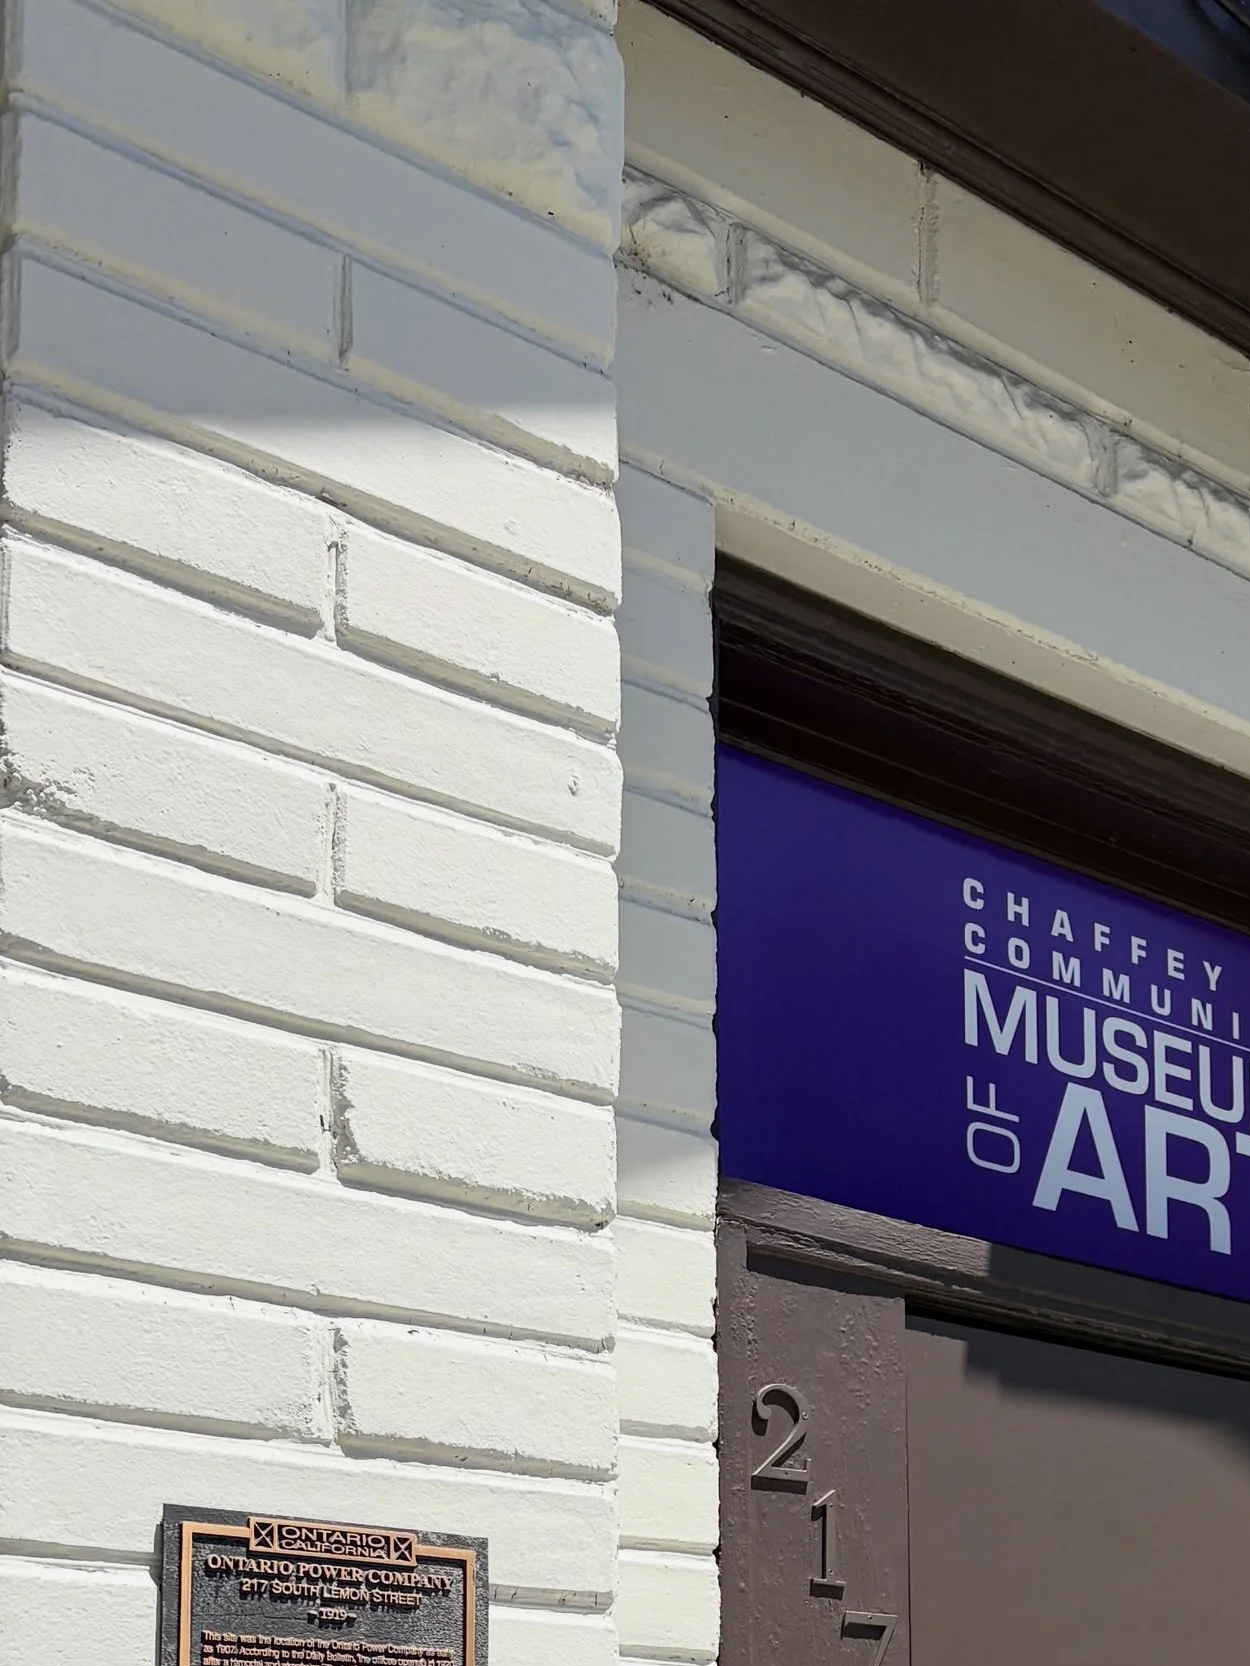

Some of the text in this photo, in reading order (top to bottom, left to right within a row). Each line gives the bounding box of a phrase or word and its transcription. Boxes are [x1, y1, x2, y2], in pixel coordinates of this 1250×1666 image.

[963, 877, 1223, 992] CHAFFEY
[966, 1075, 1021, 1174] OF
[281, 1540, 389, 1560] CALIFORNIA
[282, 1526, 385, 1547] ONTARIO
[207, 1554, 453, 1590] ONTARIO POWER COMPANY
[241, 1579, 424, 1606] 217 SOUTH LEMON STREET
[203, 1630, 220, 1641] This
[222, 1632, 237, 1642] site
[240, 1634, 256, 1644] was
[258, 1634, 271, 1644] the
[274, 1635, 305, 1647] location
[331, 1640, 359, 1650] Ontario
[362, 1641, 386, 1653] Power
[387, 1644, 423, 1657] Company
[203, 1645, 213, 1653] as
[240, 1646, 280, 1659] According
[282, 1649, 289, 1658] to
[292, 1650, 304, 1659] the
[306, 1651, 325, 1662] Daily
[372, 1656, 397, 1665] offices
[203, 1656, 221, 1666] after
